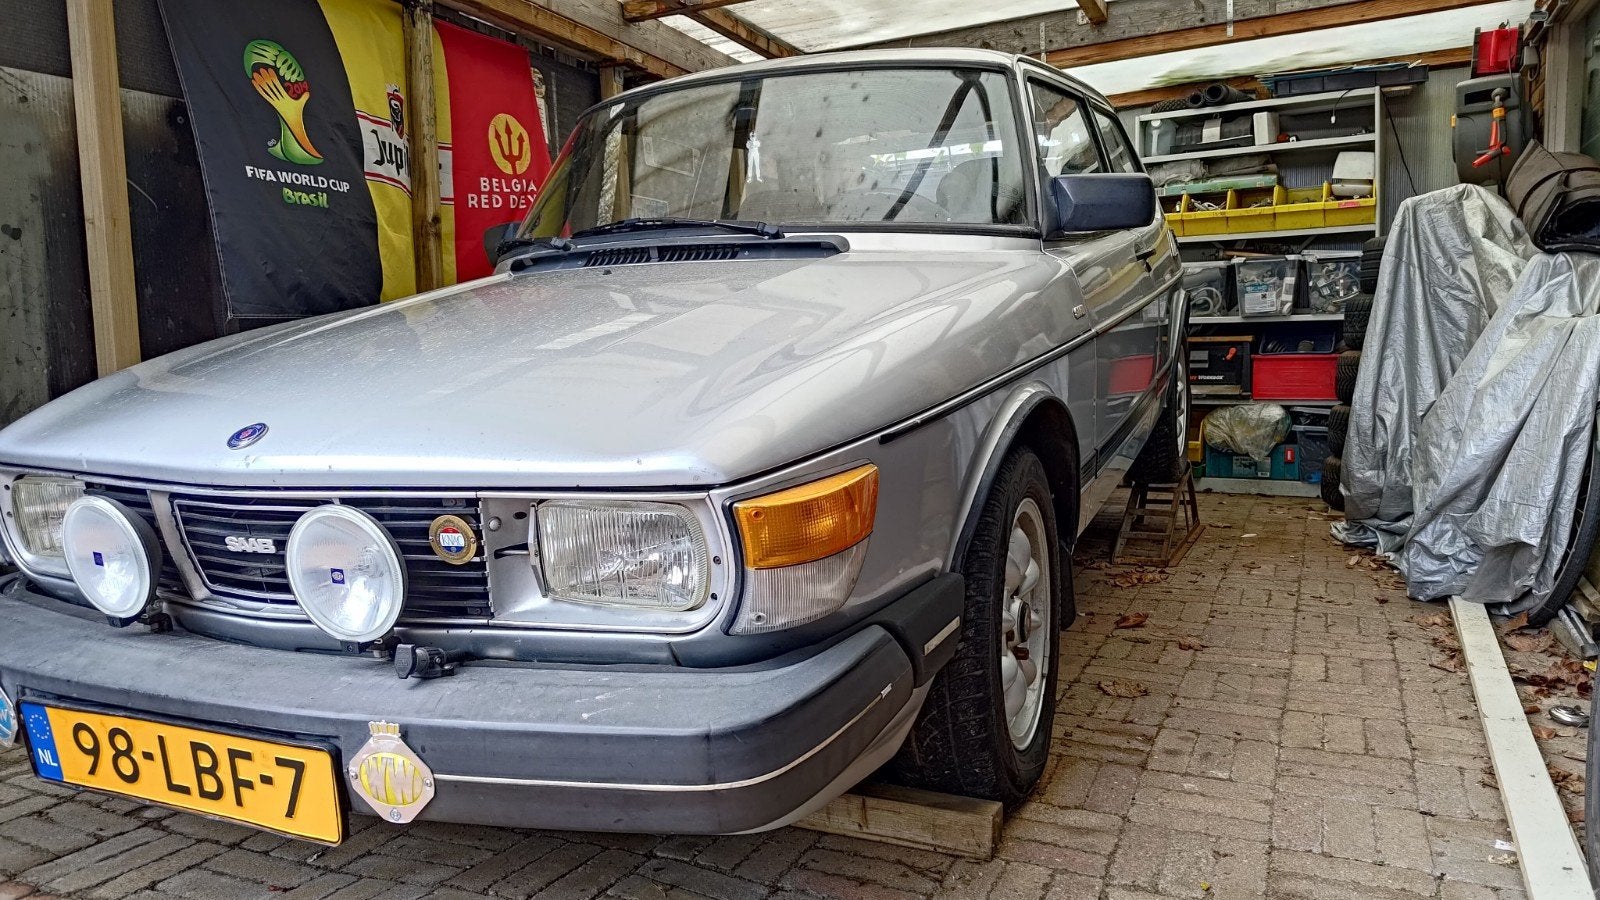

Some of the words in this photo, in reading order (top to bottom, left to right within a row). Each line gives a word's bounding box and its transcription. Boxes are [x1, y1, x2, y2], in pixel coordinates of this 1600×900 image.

[245, 165, 277, 182] FIFA
[277, 171, 328, 189] WORLD
[329, 179, 350, 193] CUP
[480, 176, 537, 192] BELGIA
[282, 187, 329, 209] Brasil
[468, 193, 502, 209] RED
[225, 536, 276, 554] SAAB
[38, 748, 58, 767] NL
[72, 722, 305, 818] 98-LBF-7
